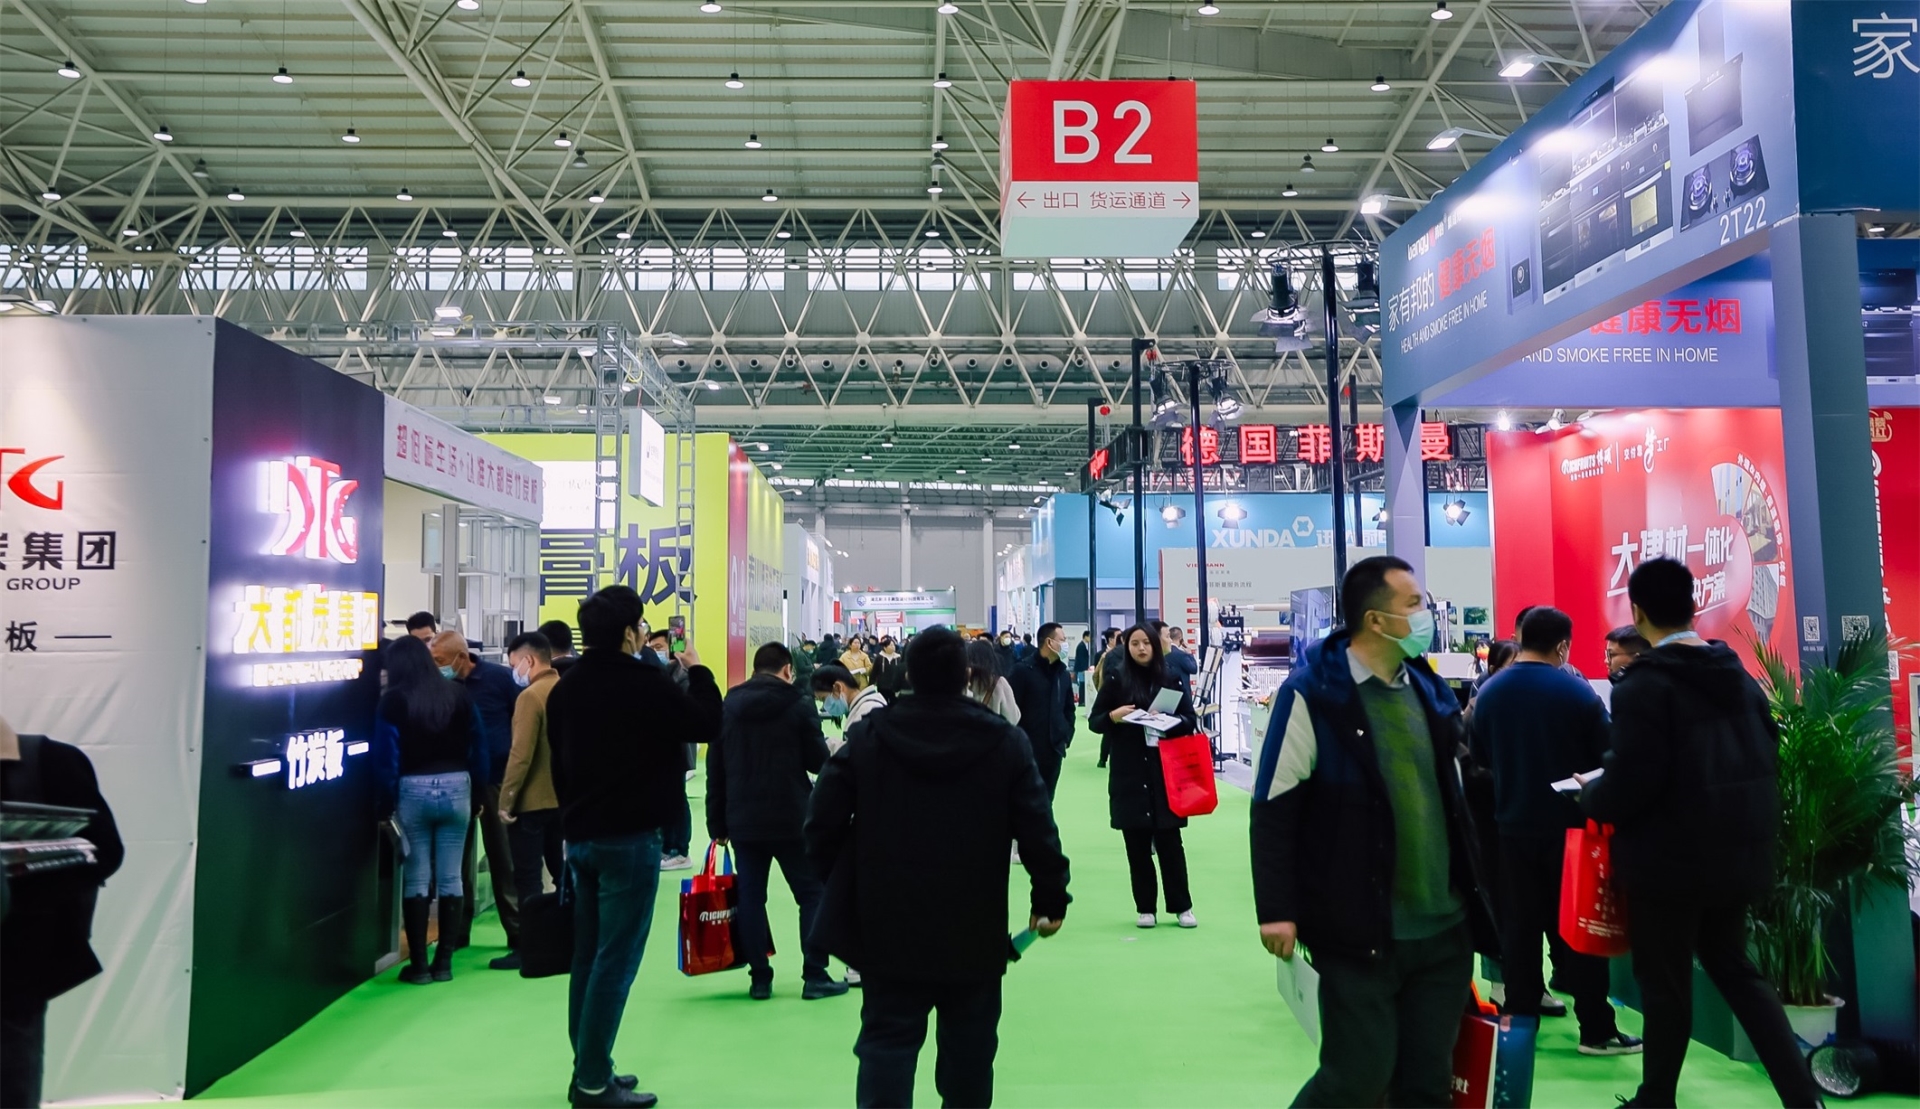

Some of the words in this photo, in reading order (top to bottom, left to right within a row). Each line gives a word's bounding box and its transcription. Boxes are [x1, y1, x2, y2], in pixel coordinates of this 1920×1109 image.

[1852, 12, 1920, 79] 家
[1053, 100, 1153, 164] B2
[1043, 191, 1079, 209] 出口
[1090, 191, 1166, 209] 货运通道
[1720, 197, 1767, 246] 2T22
[1556, 347, 1610, 363] SMOKE
[1613, 347, 1653, 363] FREE
[1656, 347, 1672, 363] IN
[1674, 347, 1719, 363] HOME
[0, 531, 116, 570] 集团
[1211, 528, 1296, 548] XUNDA
[6, 577, 81, 591] GROUP
[286, 729, 345, 790] 竹炭板
